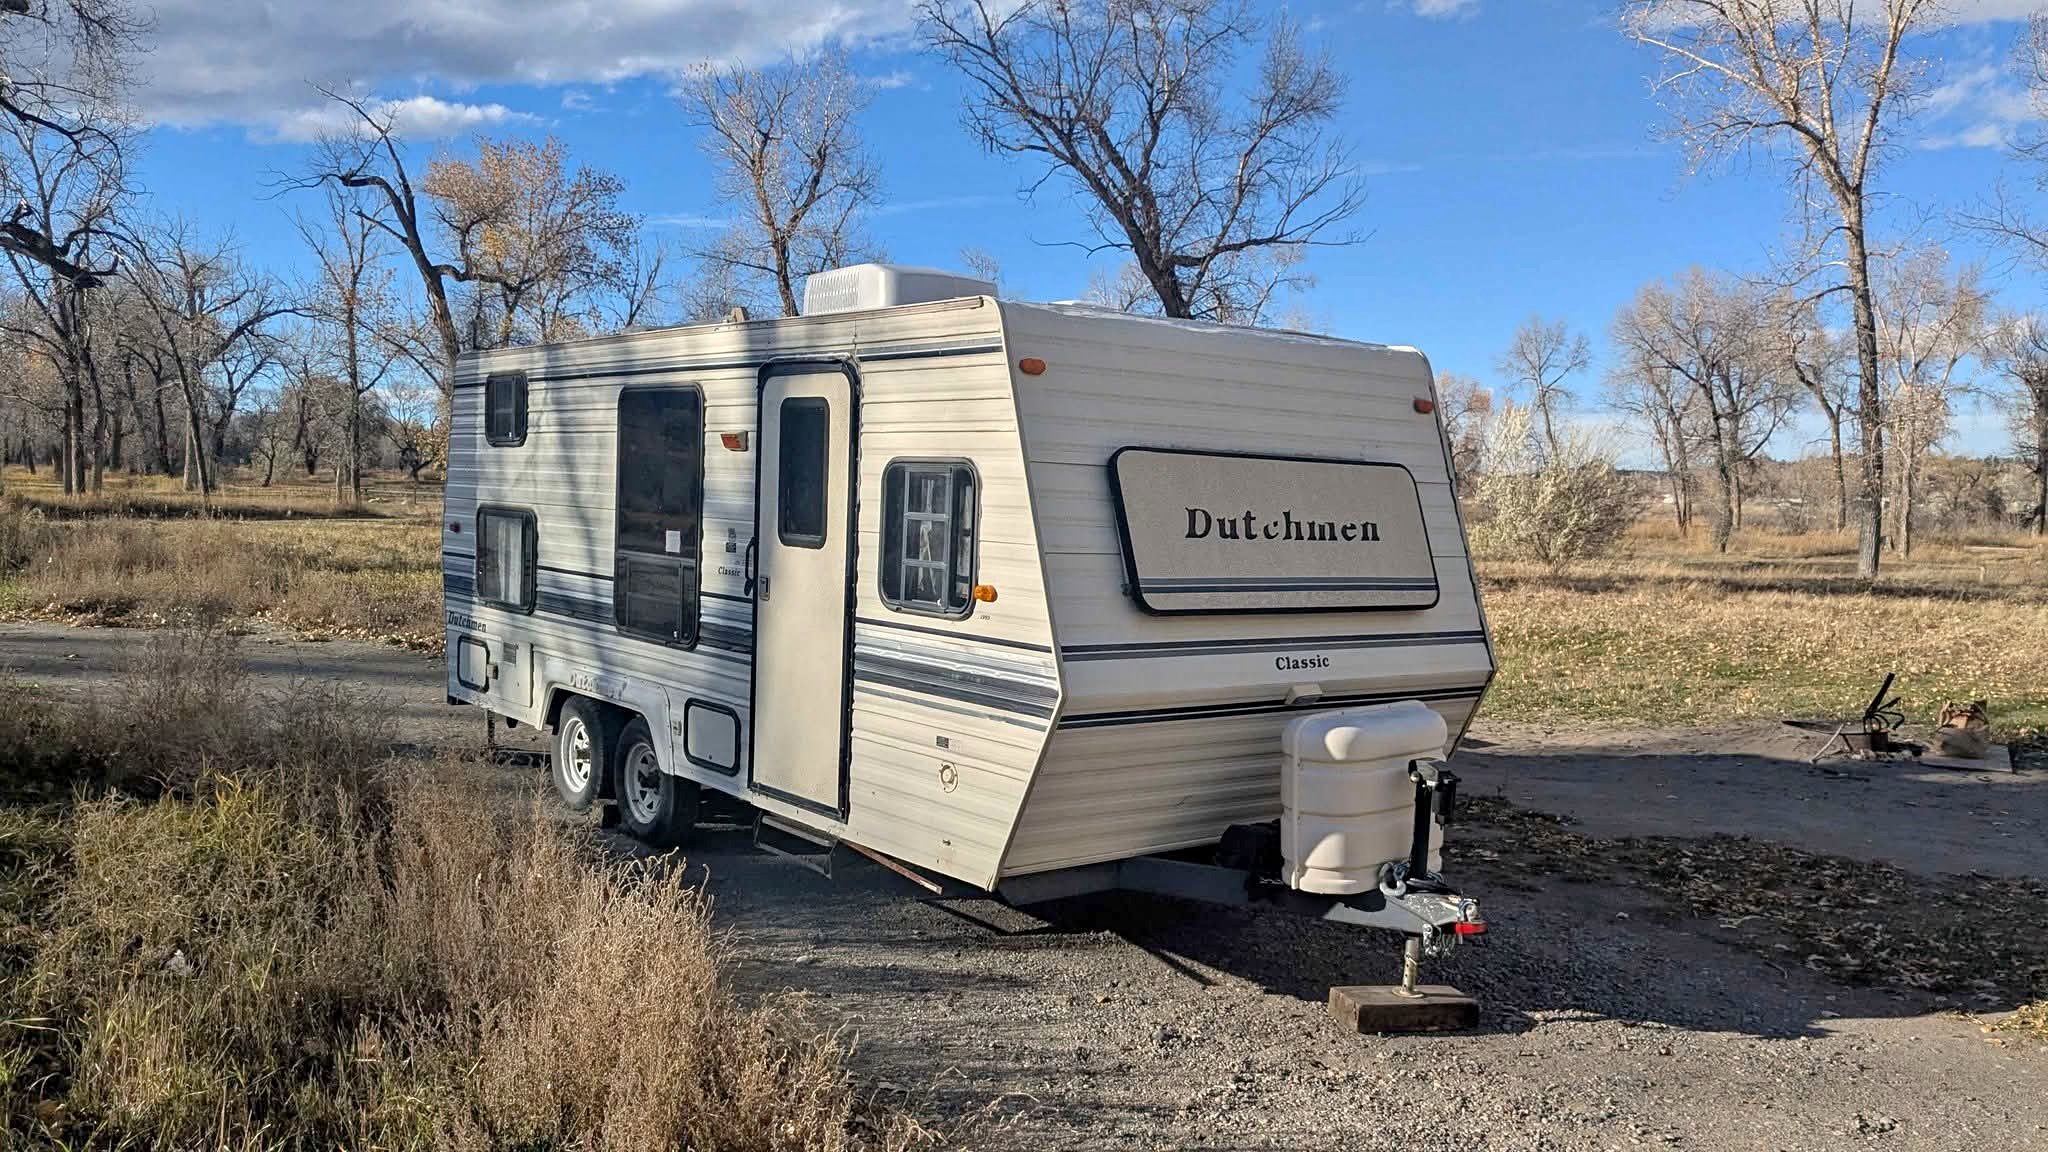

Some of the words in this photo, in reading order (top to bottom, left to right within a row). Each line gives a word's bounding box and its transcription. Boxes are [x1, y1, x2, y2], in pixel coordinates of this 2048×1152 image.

[1185, 507, 1380, 542] Dutchmen
[718, 566, 740, 577] Classic
[448, 611, 487, 633] Dutchmen
[1275, 654, 1330, 671] Classic
